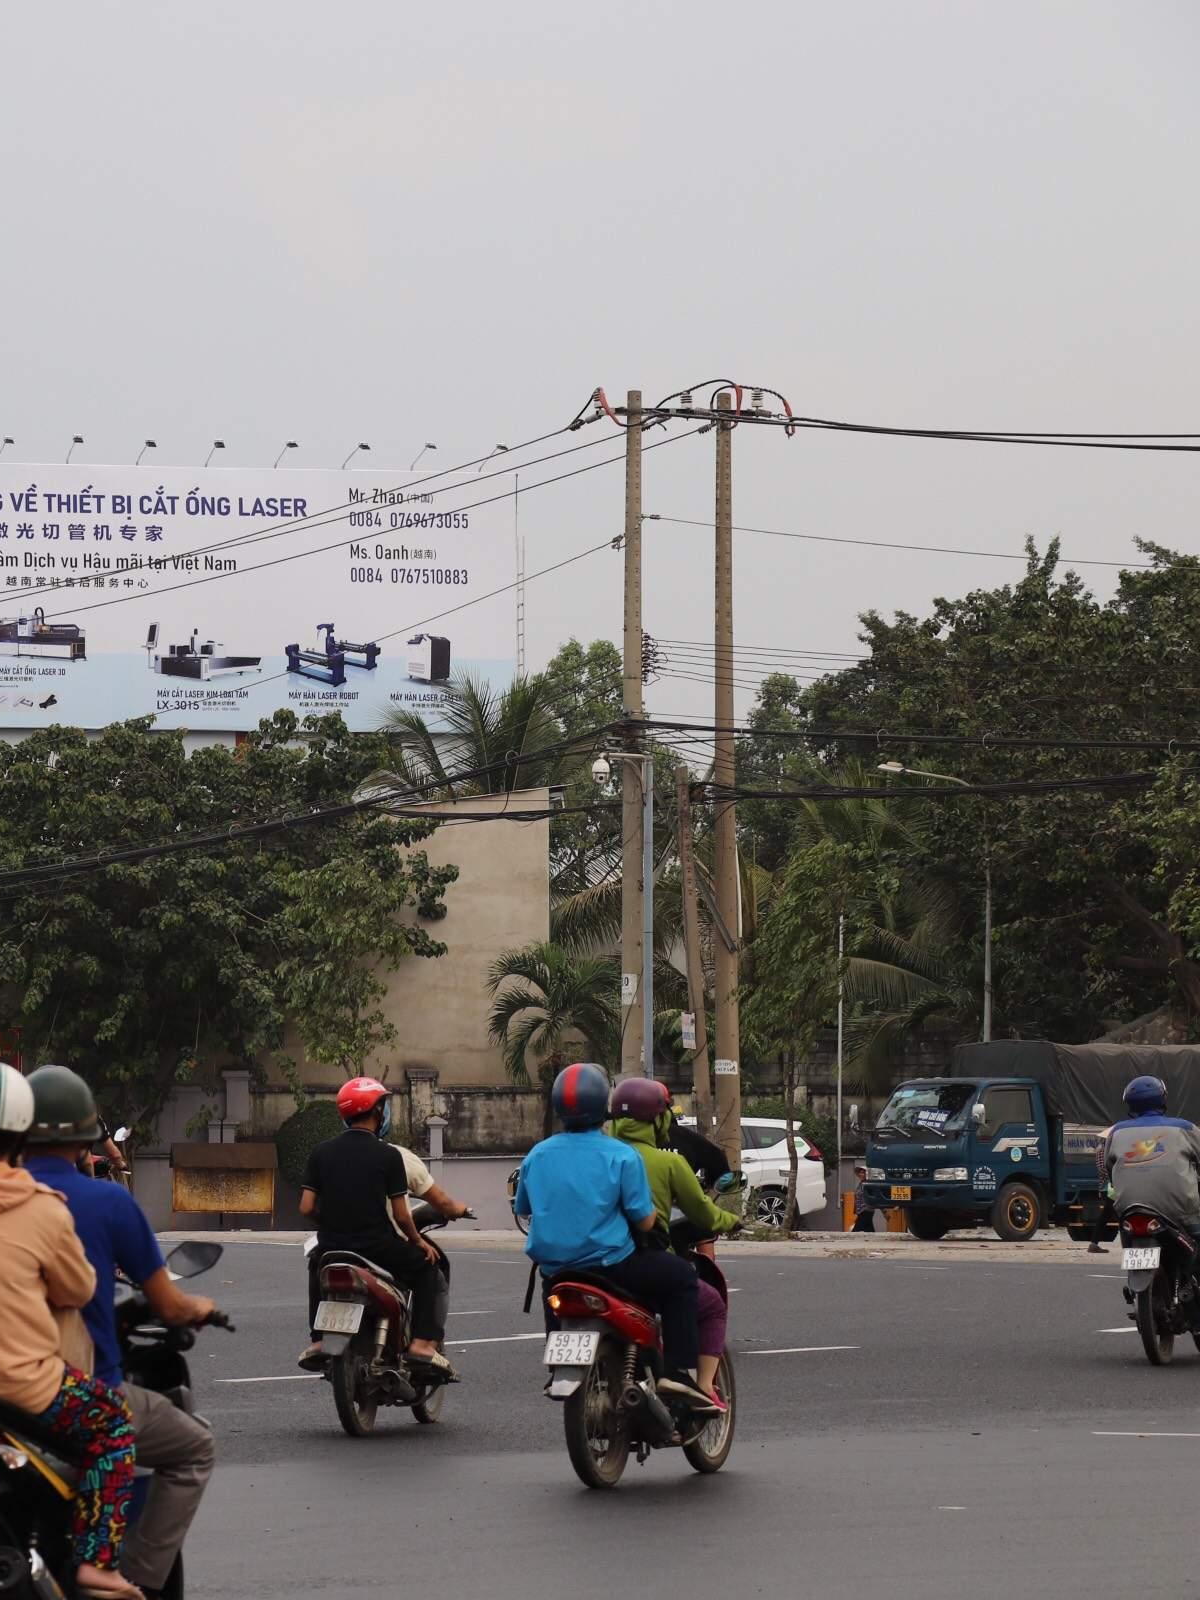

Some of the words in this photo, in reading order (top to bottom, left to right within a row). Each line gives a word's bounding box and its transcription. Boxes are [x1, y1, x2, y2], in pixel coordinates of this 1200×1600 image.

[9, 484, 38, 514] VỀ
[43, 485, 103, 515] THIẾT
[111, 497, 133, 520] BỊ
[138, 485, 180, 516] CẮT
[185, 486, 232, 517] ỐNG
[238, 497, 308, 518] LASER
[348, 488, 369, 504] Mr.
[372, 488, 404, 504] Zhao
[349, 512, 382, 528] 0084
[390, 512, 469, 529] 0769673055
[350, 544, 372, 560] Ms.
[375, 544, 409, 560] Oanh
[24, 552, 56, 572] Dịch
[61, 556, 78, 573] vụ
[83, 553, 110, 573] Hậu
[115, 552, 143, 570] mãi
[149, 554, 168, 574] tại
[171, 553, 200, 575] Việt
[204, 555, 237, 571] Nam
[350, 567, 383, 583] 0084
[391, 568, 468, 585] 0767510883
[0, 665, 11, 675] MÁY
[38, 668, 57, 676] LASER
[156, 688, 170, 698] MÁY
[185, 690, 205, 698] LASER
[288, 689, 302, 700] MÁY
[303, 689, 316, 700] HÀN
[317, 692, 338, 700] LASER
[339, 692, 359, 700] ROBOT
[390, 691, 403, 701] MÁY
[418, 693, 438, 702] LASER
[156, 700, 200, 710] LX-3015
